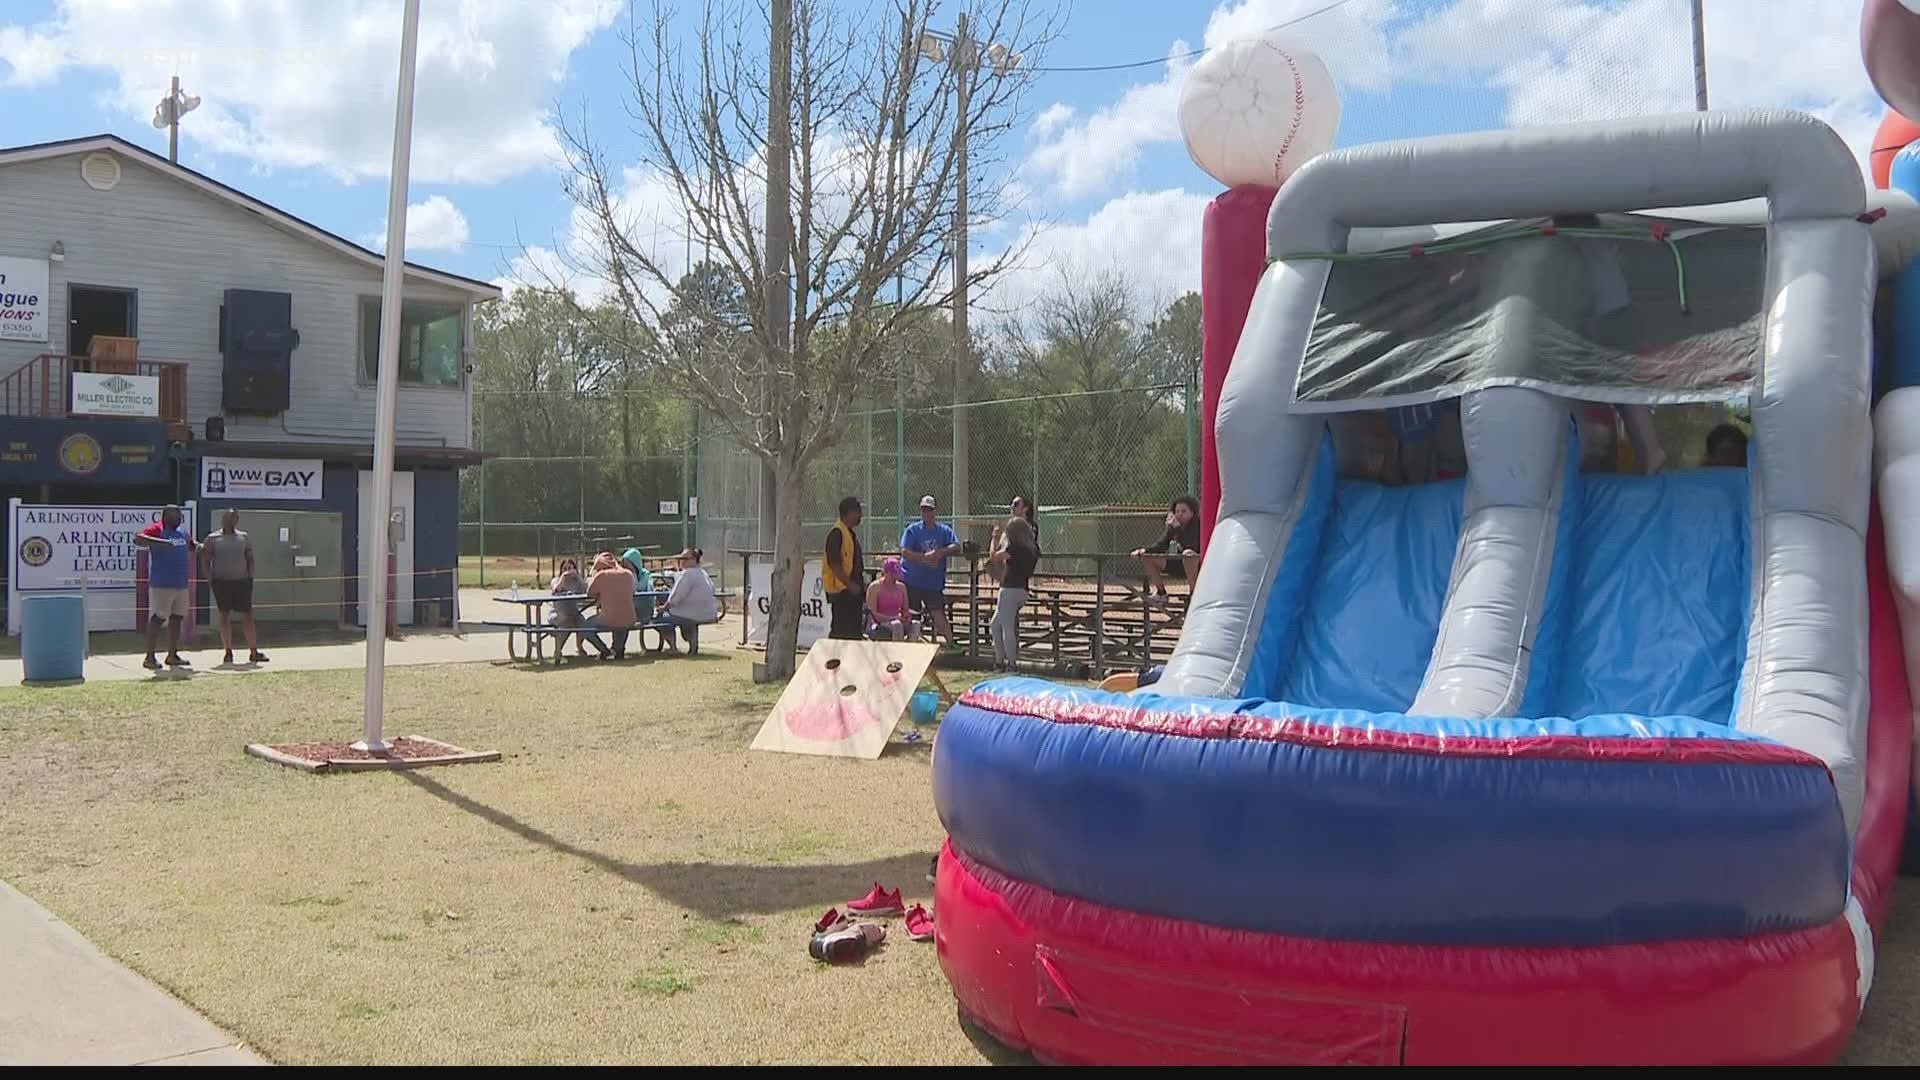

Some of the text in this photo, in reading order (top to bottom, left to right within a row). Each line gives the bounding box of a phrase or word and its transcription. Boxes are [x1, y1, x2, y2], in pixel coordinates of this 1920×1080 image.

[78, 393, 104, 402] MILLER
[106, 394, 140, 404] ELECTRIC
[229, 469, 314, 486] W.W. GAY
[25, 511, 104, 524] ARLINGTON
[111, 511, 146, 523] LIONS
[77, 545, 136, 558] LITTLE
